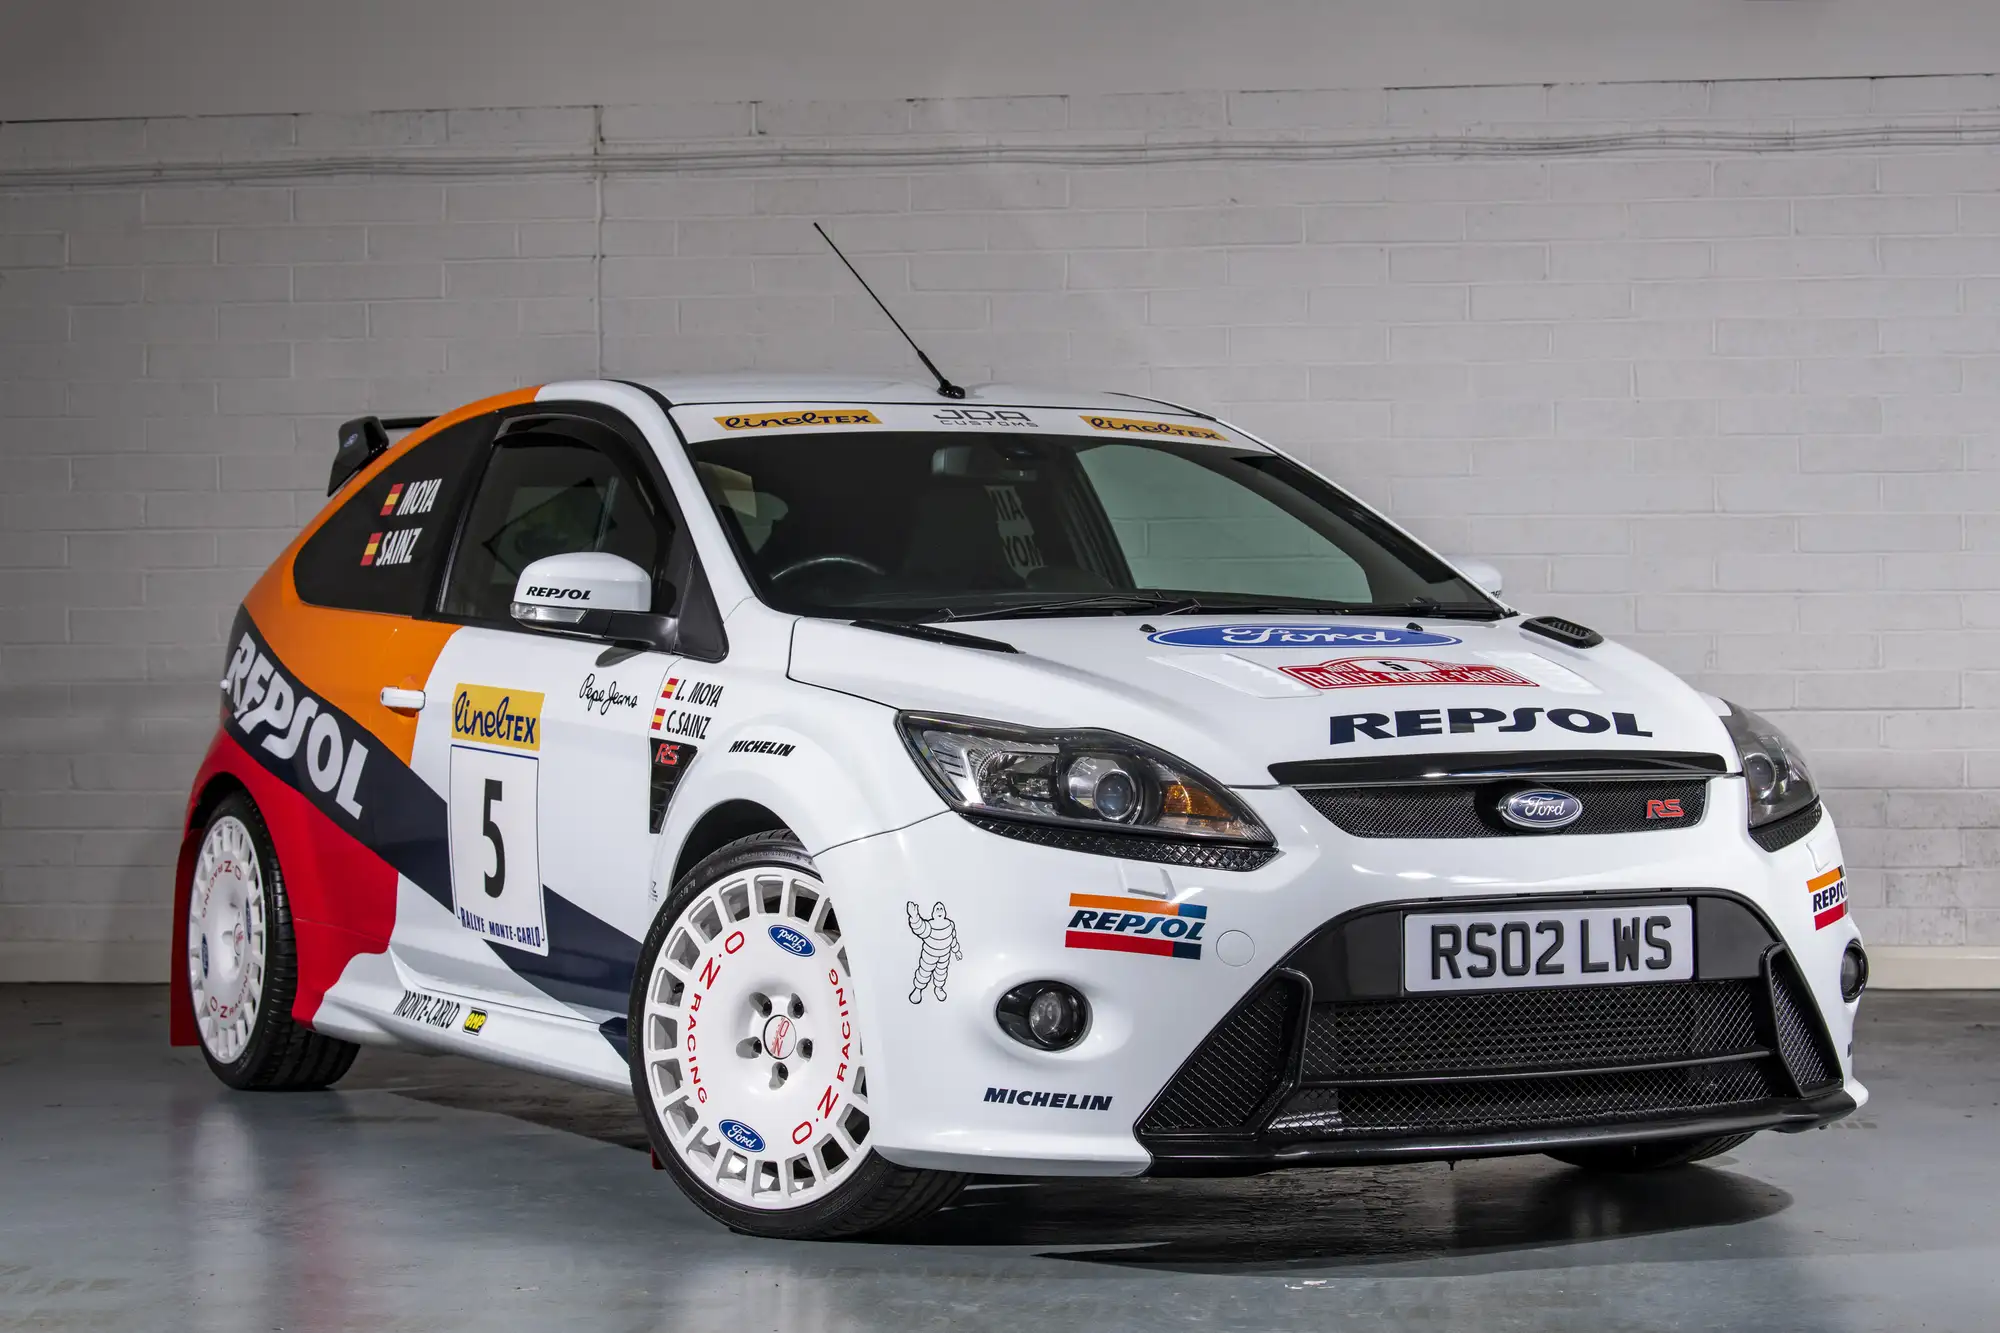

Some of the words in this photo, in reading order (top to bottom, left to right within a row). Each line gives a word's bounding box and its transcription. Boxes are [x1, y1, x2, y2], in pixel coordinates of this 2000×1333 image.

[933, 409, 1031, 421] JDA
[940, 419, 1039, 428] CUSTOMS
[396, 478, 442, 516] MOYA
[376, 528, 422, 566] SAINZ
[526, 586, 592, 600] REPSOL
[1222, 626, 1402, 644] Ford
[1299, 671, 1388, 686] RALLYE
[1382, 670, 1523, 683] MONTE-CARLO
[1378, 661, 1409, 671] 5
[580, 673, 606, 711] Pepe
[601, 682, 638, 715] Jeans
[675, 680, 687, 702] L.
[687, 681, 724, 708] MOYA
[227, 632, 370, 820] REPSOL
[1329, 706, 1653, 746] REPSOL
[655, 743, 680, 766] RS
[728, 740, 796, 758] MICHELIN
[1524, 795, 1566, 818] Ford
[1646, 798, 1685, 819] RS
[482, 778, 506, 899] 5
[1813, 881, 1848, 913] REPSO
[460, 907, 486, 932] RALLYE
[489, 919, 543, 948] MONTE-CARLO
[1068, 910, 1207, 941] REPSOL
[1431, 919, 1565, 980] RS02
[1580, 915, 1672, 973] LWS
[393, 990, 460, 1030] MONTE-CARLO
[465, 1012, 486, 1030] OMP
[828, 968, 852, 1083] RACING
[687, 993, 708, 1104] RACING
[984, 1087, 1113, 1111] MICHELIN
[725, 1125, 756, 1149] Ford
